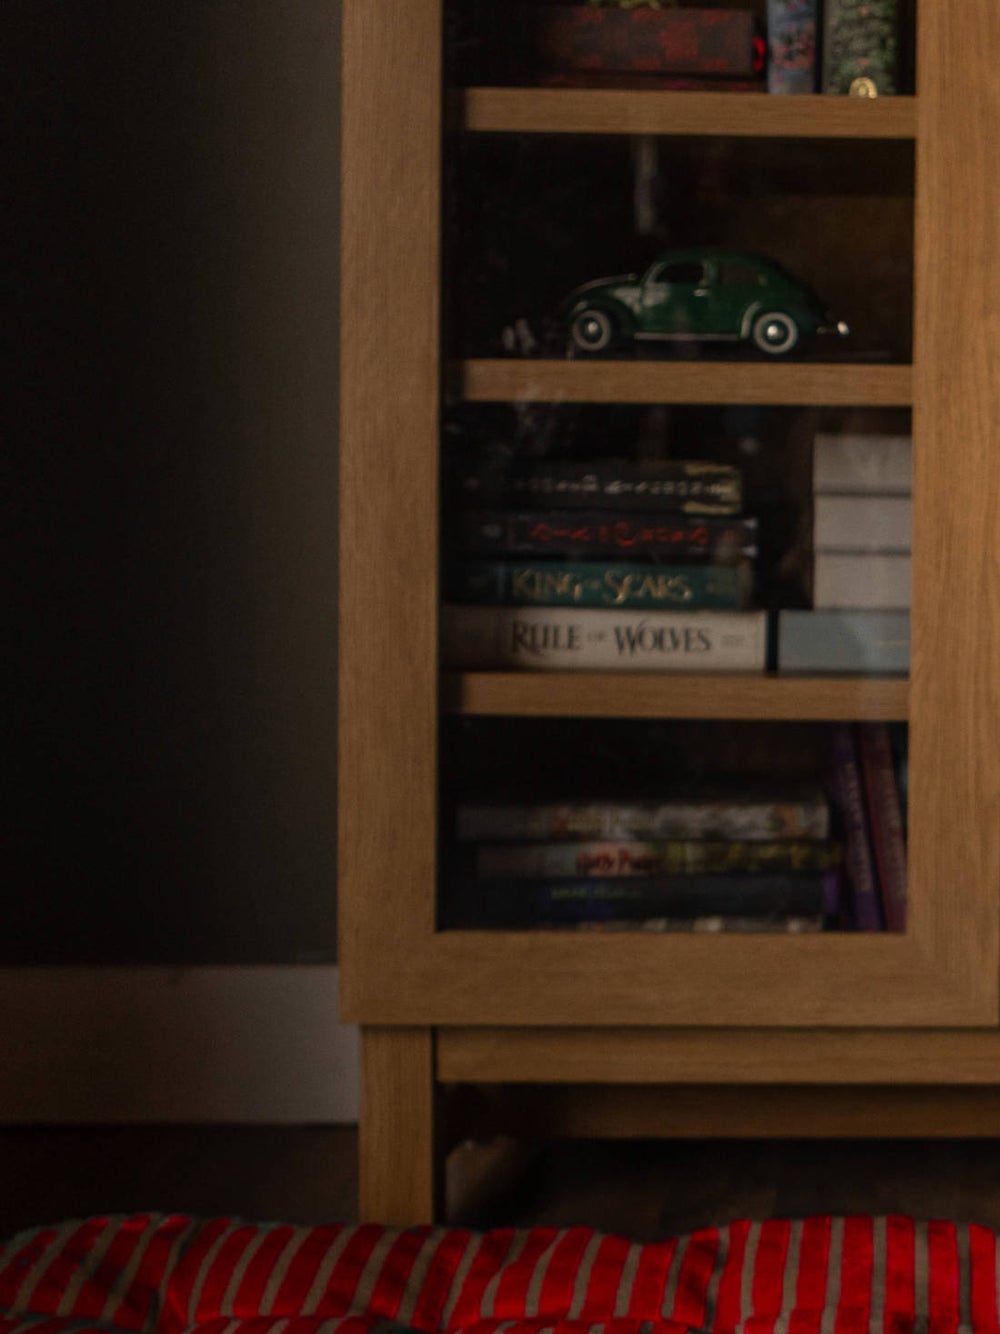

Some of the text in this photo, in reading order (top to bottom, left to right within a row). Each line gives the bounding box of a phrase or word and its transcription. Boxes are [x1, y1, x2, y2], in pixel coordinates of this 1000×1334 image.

[511, 567, 582, 602] KING
[602, 567, 692, 606] SCARS
[511, 620, 580, 656] RULE
[614, 619, 712, 656] WOLVES
